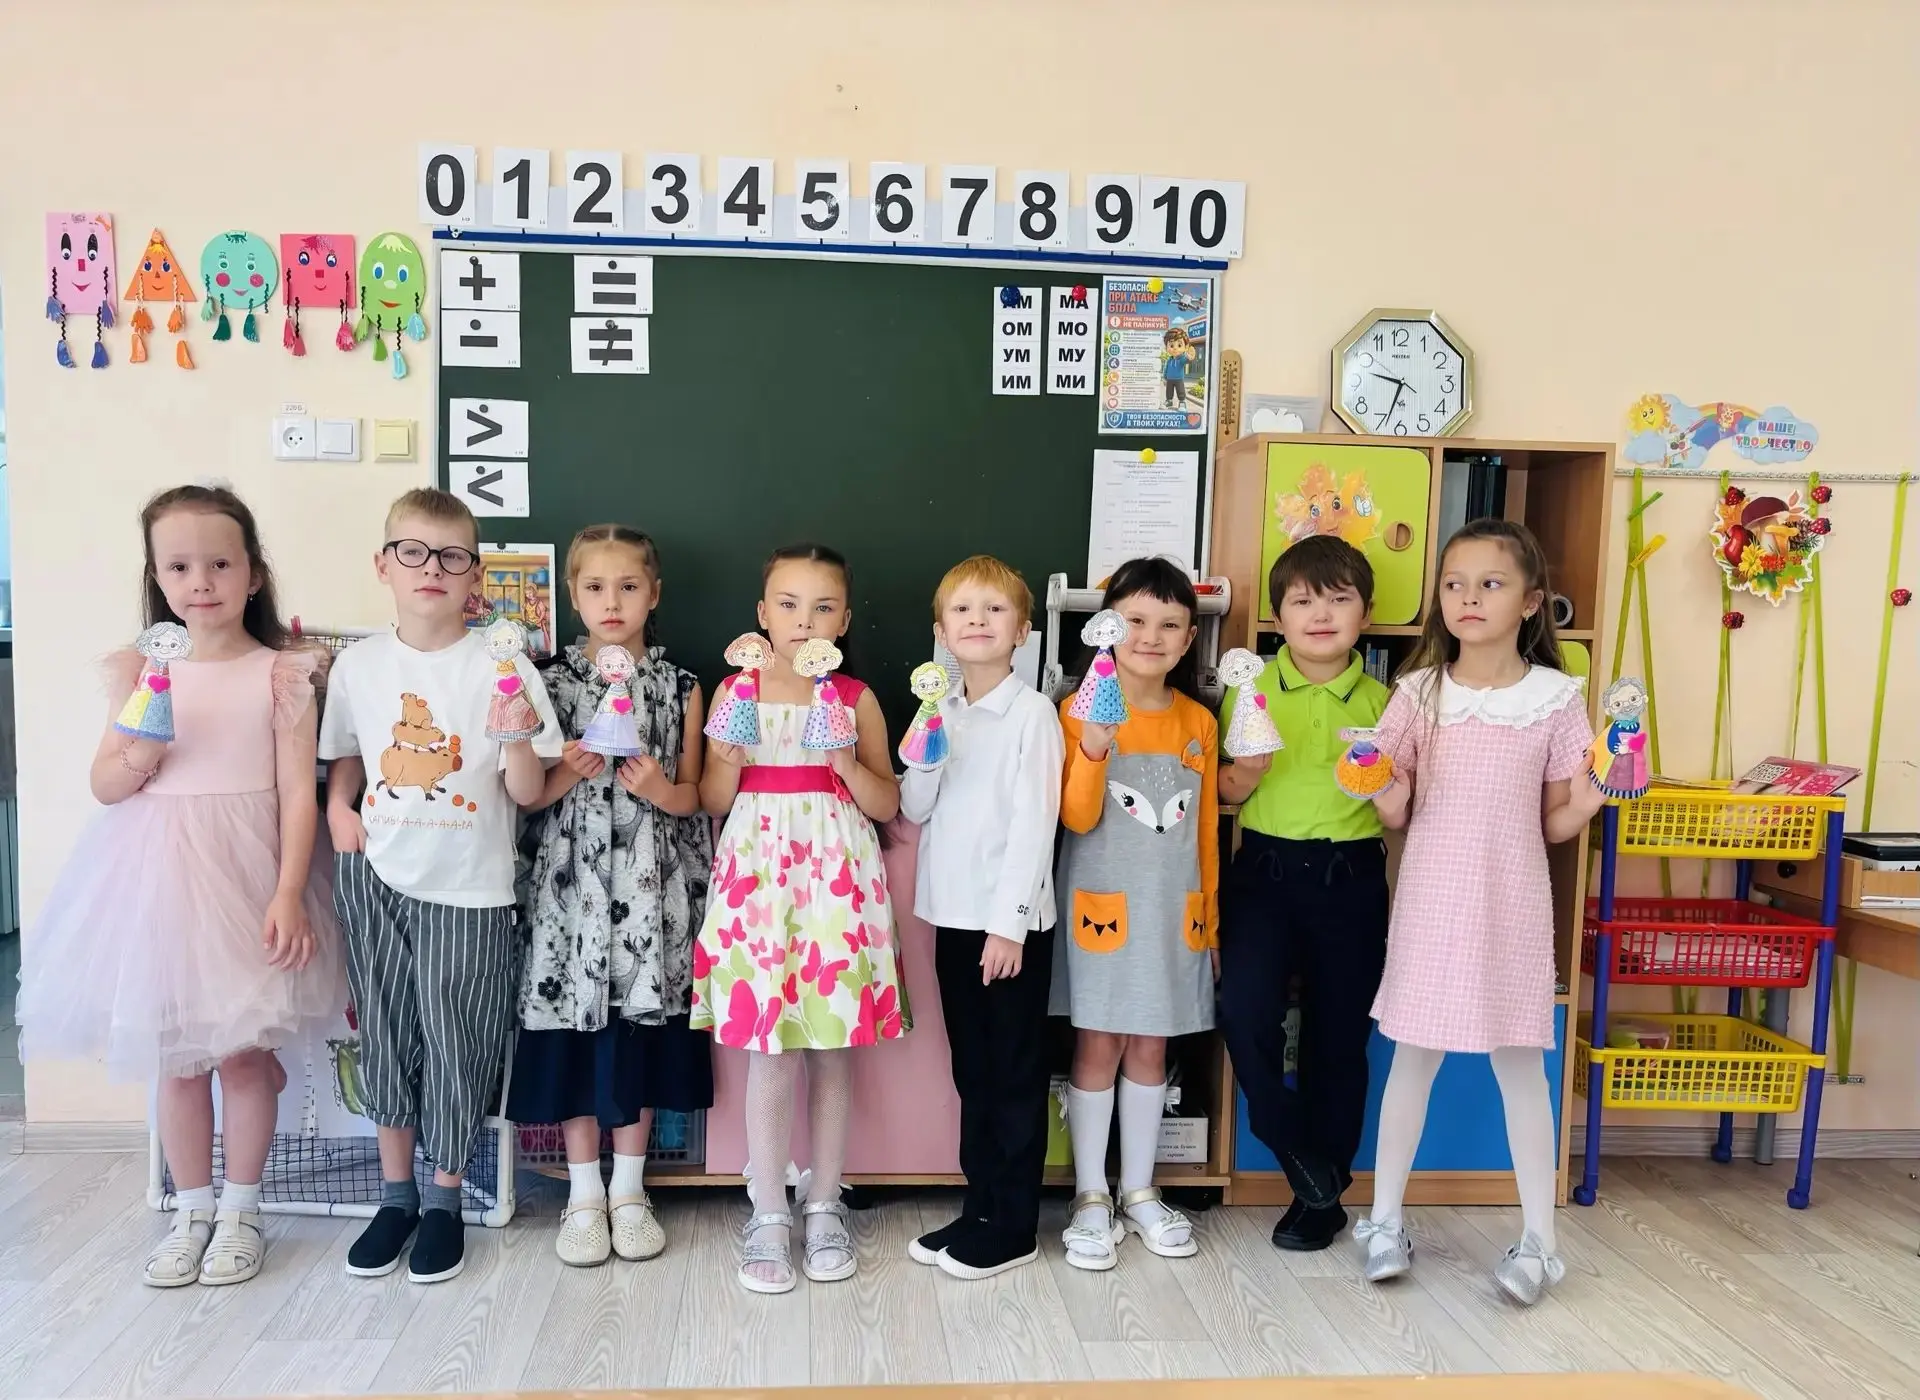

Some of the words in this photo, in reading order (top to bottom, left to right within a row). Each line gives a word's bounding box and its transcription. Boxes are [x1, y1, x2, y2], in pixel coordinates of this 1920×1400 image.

[426, 154, 466, 217] 0
[502, 159, 532, 220] 1
[573, 162, 613, 224] 2
[651, 164, 690, 224] 3
[723, 166, 766, 227] 4
[800, 172, 840, 232] 5
[875, 173, 914, 234] 6
[950, 178, 989, 237] 7
[1019, 181, 1057, 241] 8
[1095, 184, 1133, 244] 9
[1153, 186, 1228, 248] 10
[1060, 295, 1089, 309] МА
[1109, 291, 1128, 302] ПРИ
[1130, 292, 1158, 303] АТАКЕ
[1109, 303, 1137, 313] БПЛА
[1002, 322, 1032, 336] ОМ
[1058, 321, 1088, 336] МО
[1134, 321, 1167, 329] ПАНИКУЙ!
[1373, 334, 1384, 352] 11
[1391, 328, 1410, 347] 12
[1420, 335, 1427, 352] 1
[1003, 349, 1030, 362] УМ
[1058, 348, 1086, 362] МУ
[1433, 351, 1447, 369] 2
[1002, 375, 1031, 389] ИМ
[1056, 375, 1085, 388] МИ
[1440, 375, 1455, 393] 3
[1355, 396, 1368, 414] 8
[1434, 398, 1447, 416] 4
[1156, 420, 1181, 428] РУКАХ!
[1373, 412, 1388, 431] 7
[1394, 420, 1407, 437] 6
[1416, 414, 1431, 432] 5
[1757, 421, 1794, 433] НАШЕ
[1735, 435, 1811, 451] ТВОРЧЕСТВО
